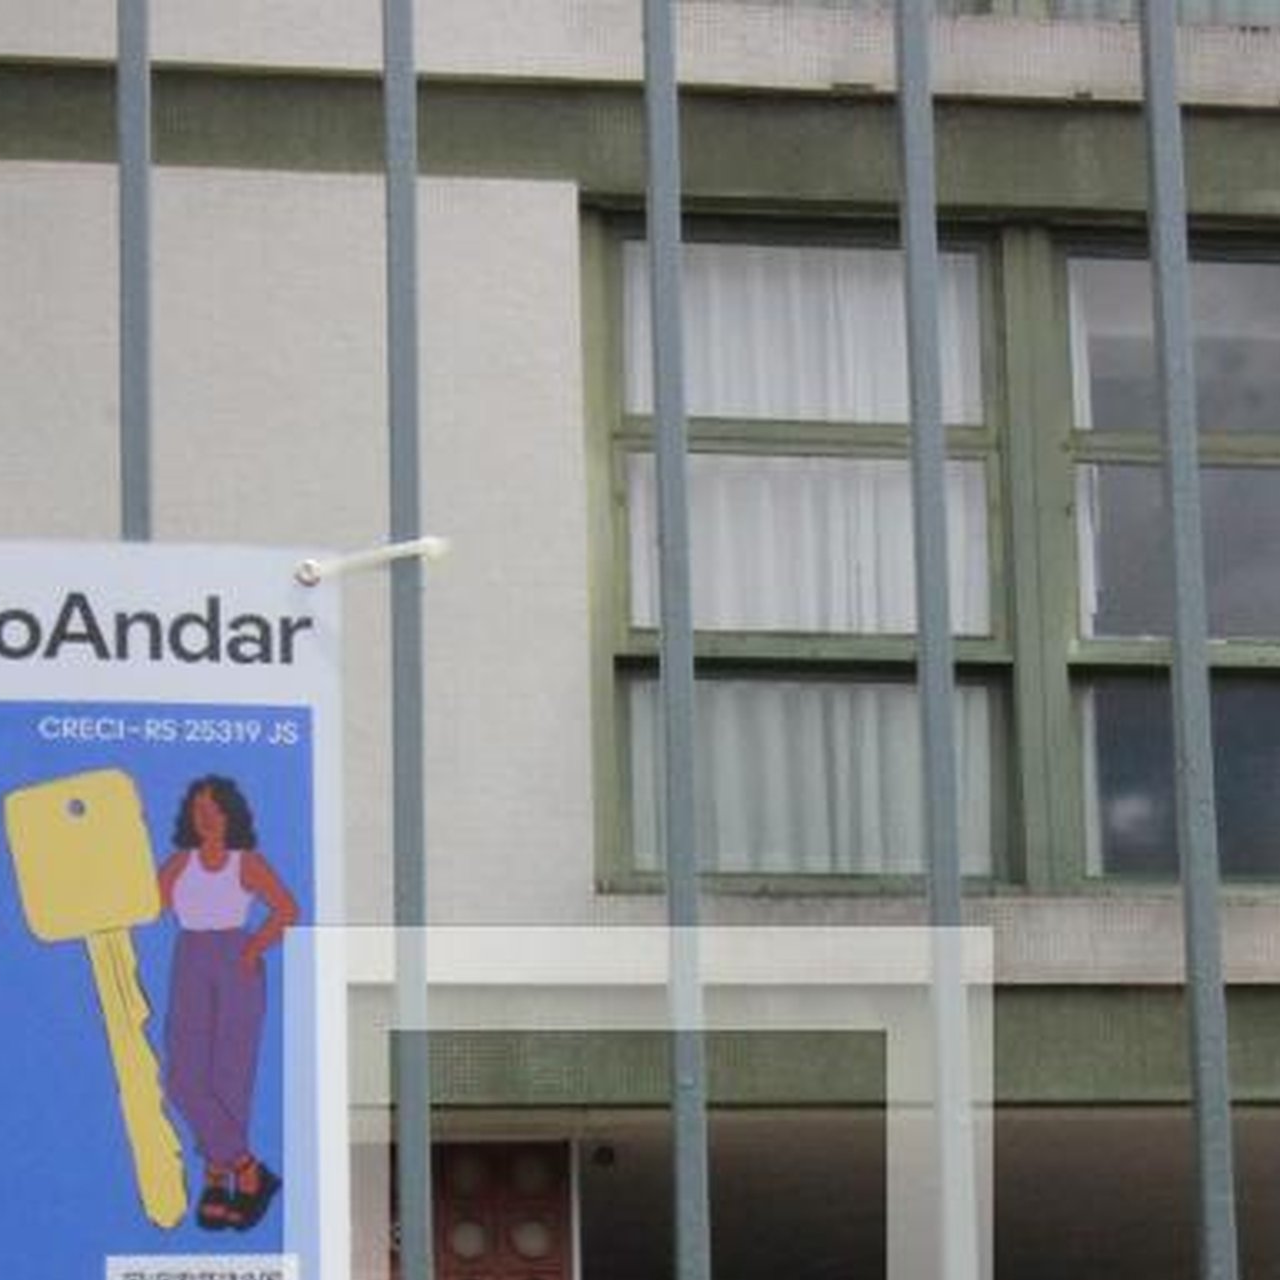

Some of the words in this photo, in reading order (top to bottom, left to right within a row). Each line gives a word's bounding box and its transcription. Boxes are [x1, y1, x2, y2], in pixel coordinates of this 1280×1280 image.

[37, 715, 179, 742] CRECI-RS
[183, 718, 263, 744] 25319
[267, 719, 301, 746] JS
